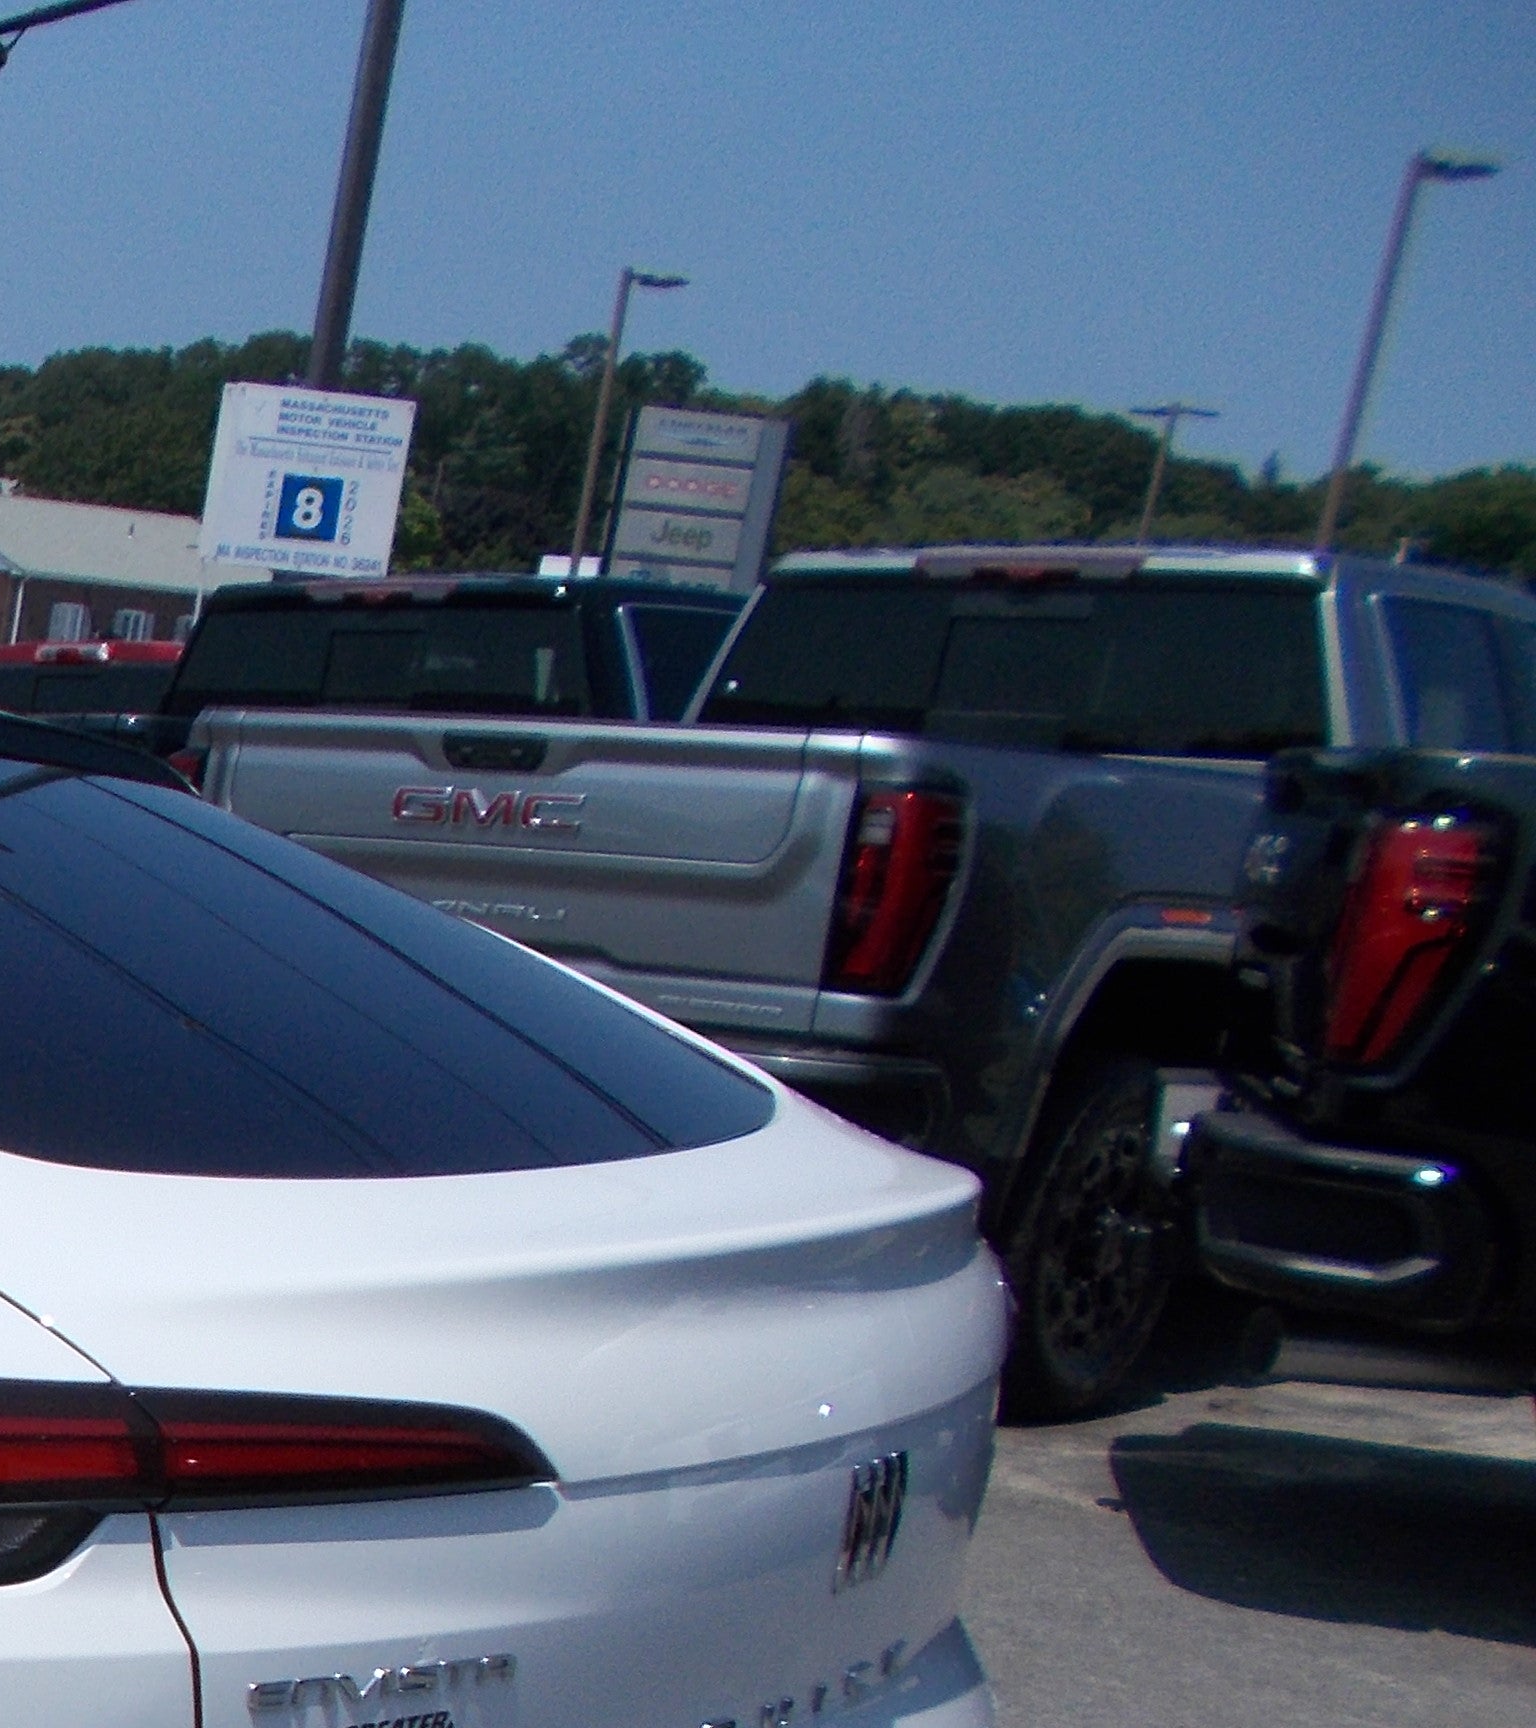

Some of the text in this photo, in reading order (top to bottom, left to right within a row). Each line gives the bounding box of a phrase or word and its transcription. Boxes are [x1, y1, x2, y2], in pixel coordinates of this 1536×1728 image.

[278, 411, 378, 432] MOTOR VEHICLE
[280, 398, 390, 420] MASSACHUSETTS
[277, 425, 403, 447] INSPECTION STATION
[291, 487, 325, 530] 8
[650, 519, 713, 550] Jeep
[392, 785, 587, 829] GMC
[246, 1652, 519, 1709] ENVISTA
